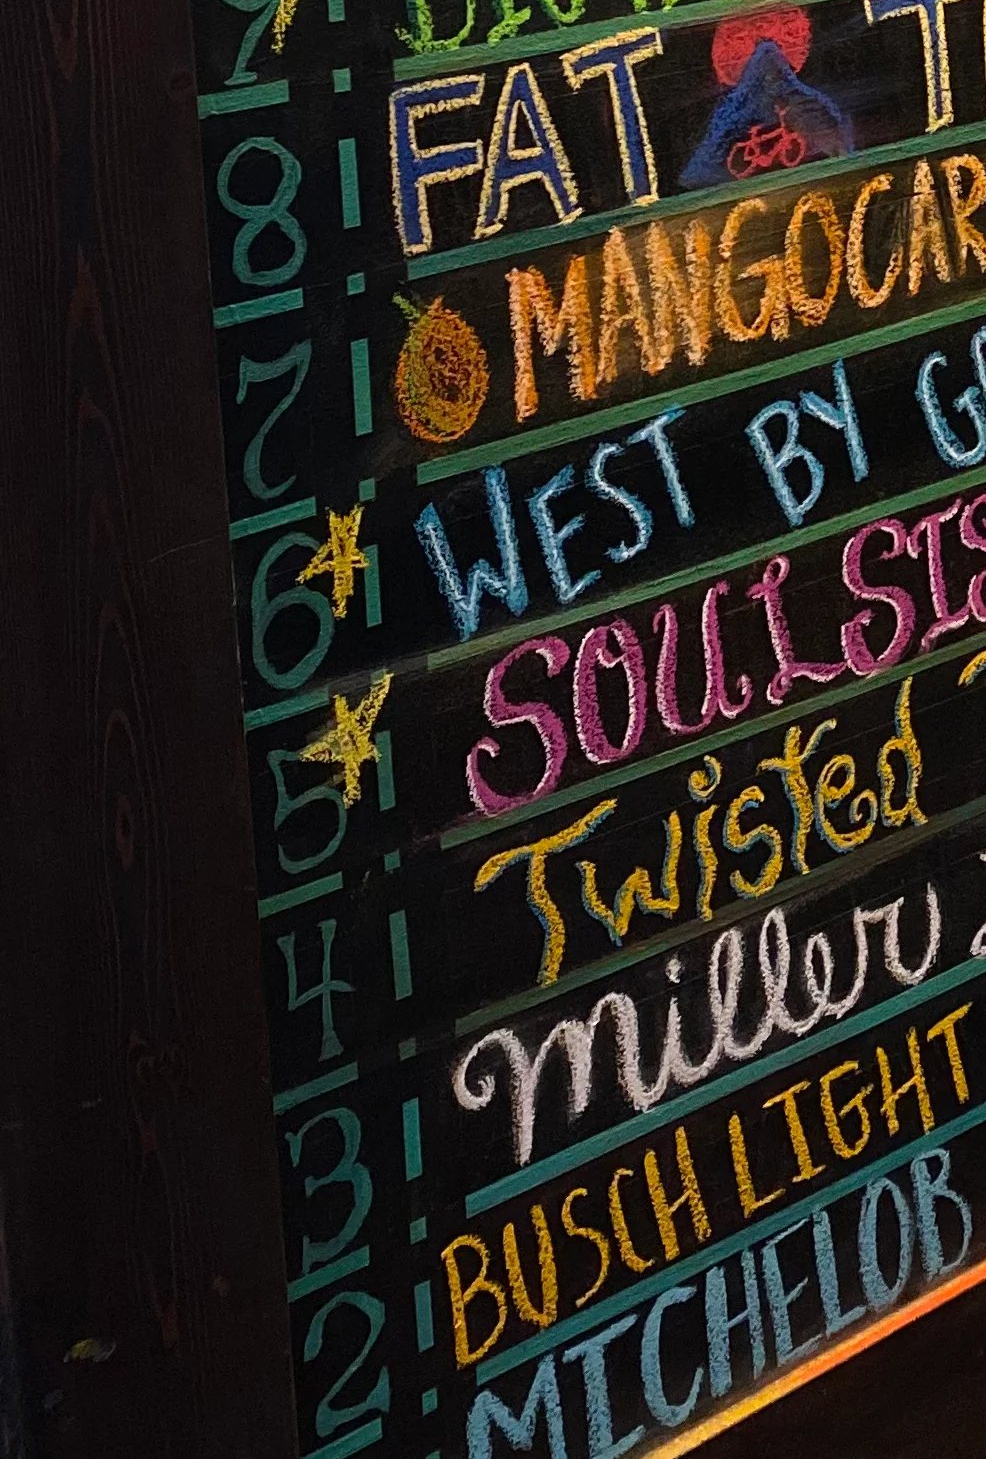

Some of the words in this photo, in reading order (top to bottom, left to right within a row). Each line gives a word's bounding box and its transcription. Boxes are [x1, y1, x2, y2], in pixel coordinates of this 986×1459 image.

[216, 136, 308, 287] 8
[387, 26, 664, 256] FAT
[235, 339, 312, 501] 7
[412, 404, 696, 643] WEST
[745, 357, 870, 529] BY
[250, 532, 336, 691] 6
[266, 746, 349, 876] 5
[473, 676, 930, 988] Twisted
[276, 918, 358, 1062] 4
[284, 1106, 374, 1275] 3
[440, 1125, 713, 1371] BUSCH
[728, 1002, 974, 1219] LIGHT
[303, 1290, 392, 1439] 2
[464, 1148, 974, 1459] MICHELOB
